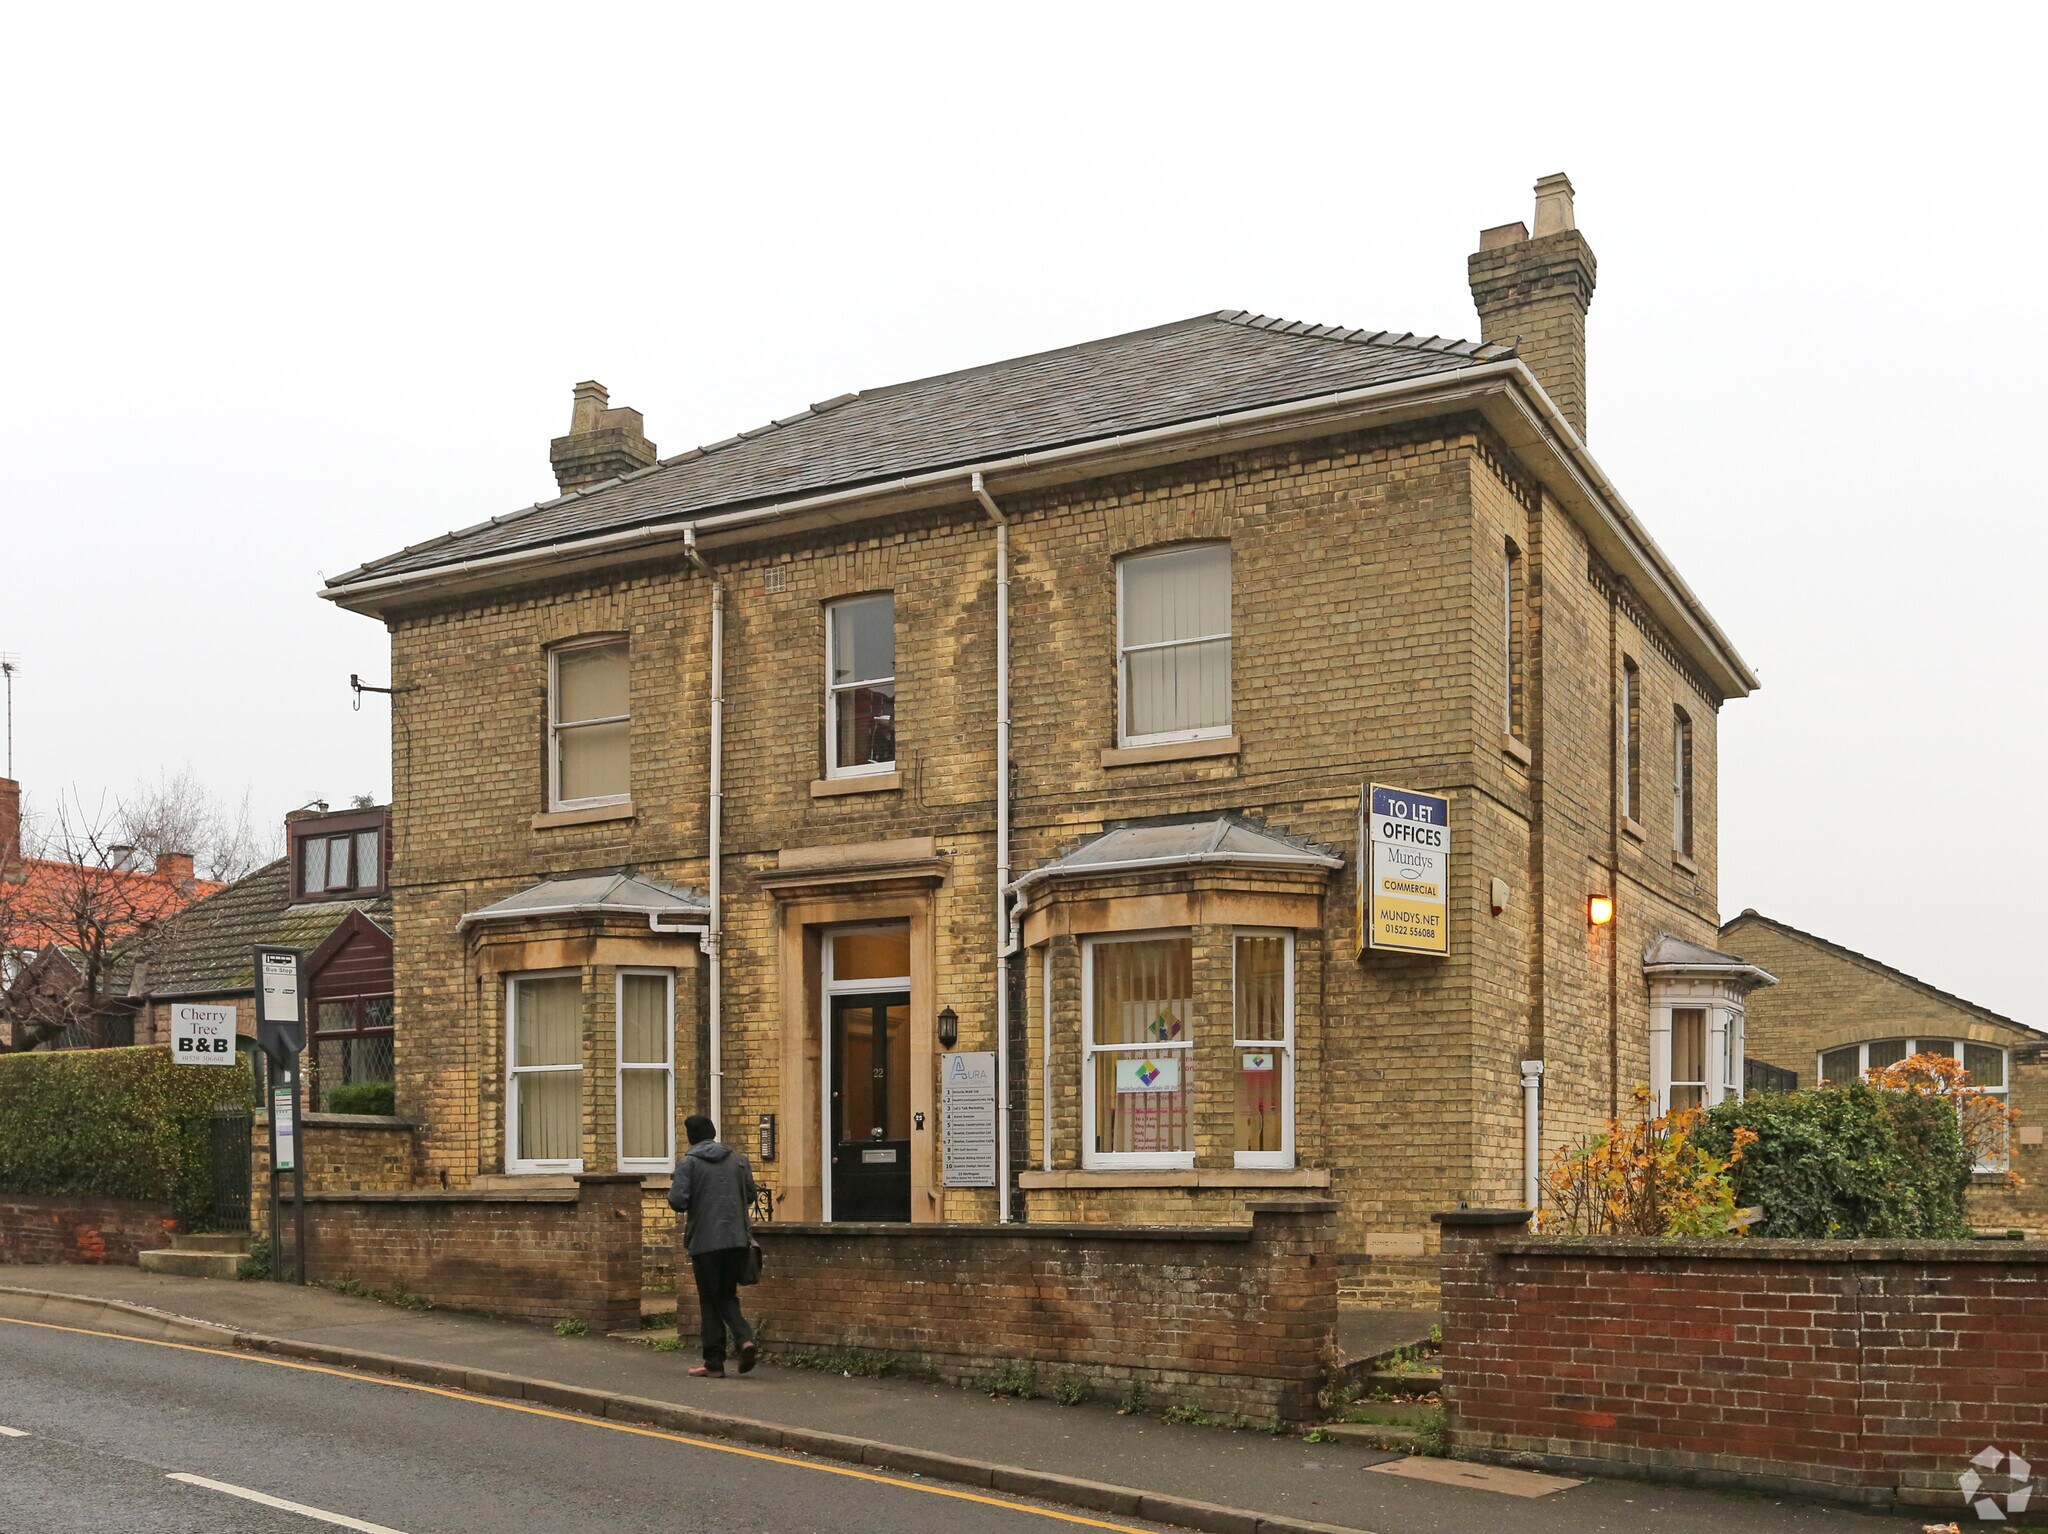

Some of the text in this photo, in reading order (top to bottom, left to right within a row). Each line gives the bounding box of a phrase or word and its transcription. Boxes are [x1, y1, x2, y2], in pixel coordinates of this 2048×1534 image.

[1388, 798, 1433, 823] TO LET
[1383, 821, 1442, 847] OFFICES
[1388, 847, 1433, 876] Mundys
[1384, 880, 1437, 896] COMMERCIAL
[1380, 909, 1440, 926] MUNDYS.NET
[1385, 923, 1435, 939] 01522 556088
[279, 967, 293, 975] Stop
[180, 1007, 227, 1024] Cherry
[190, 1022, 218, 1035] Tree
[178, 1037, 228, 1053] B&B
[873, 1068, 884, 1078] 22
